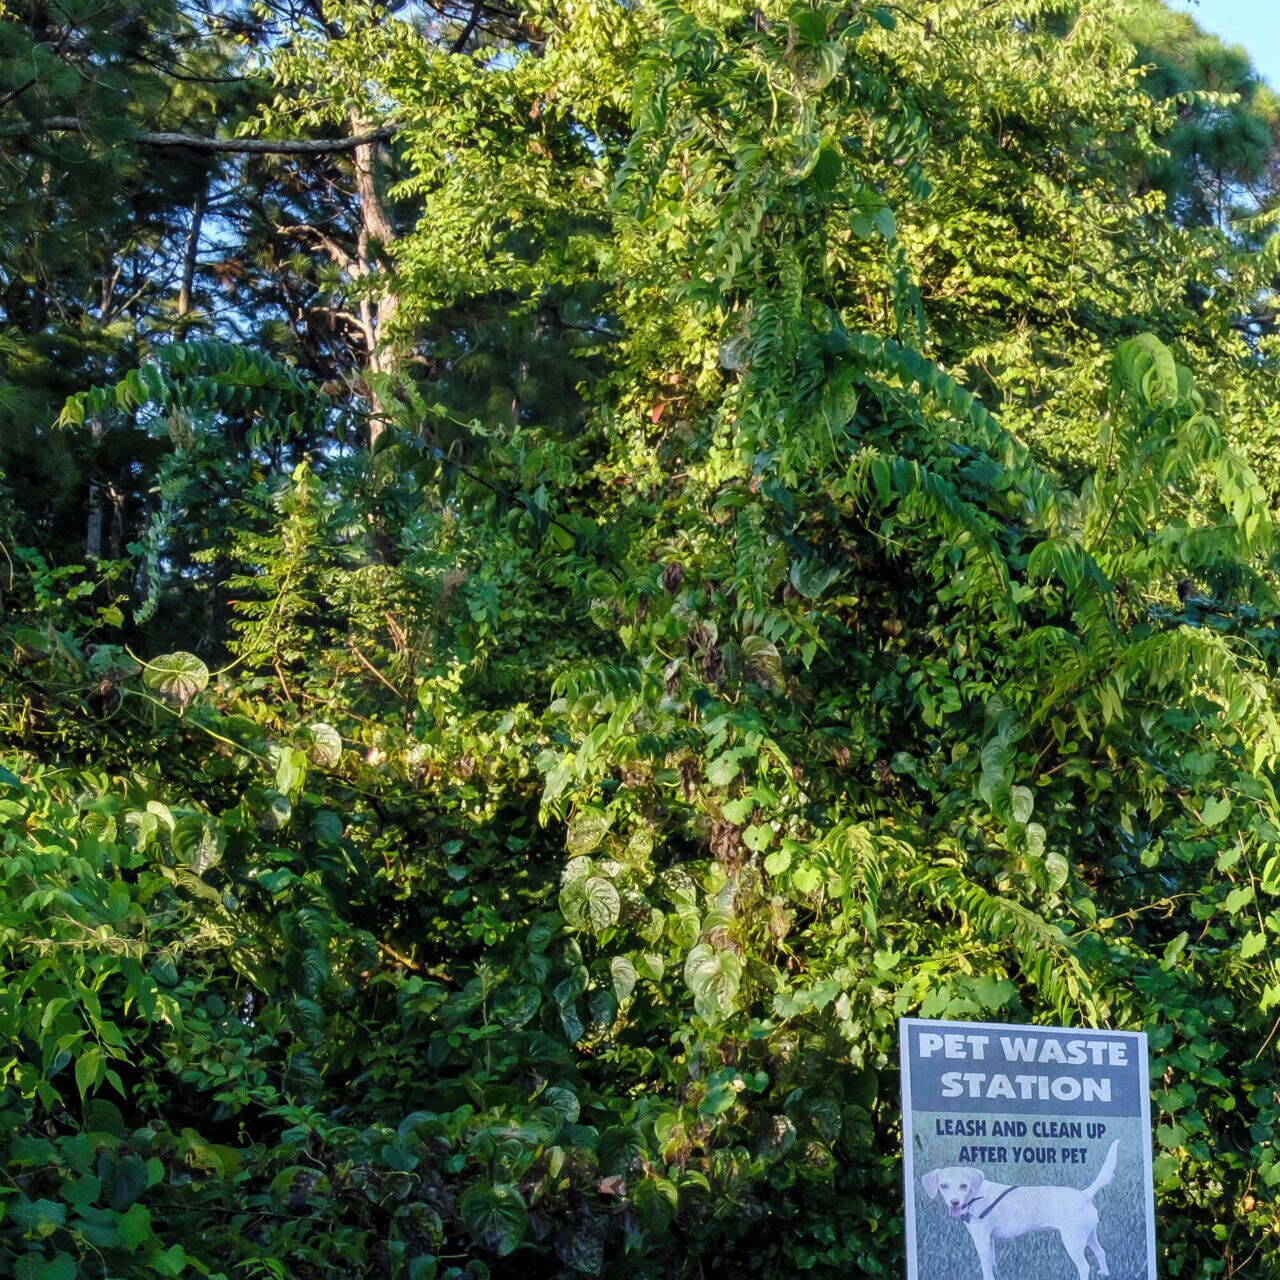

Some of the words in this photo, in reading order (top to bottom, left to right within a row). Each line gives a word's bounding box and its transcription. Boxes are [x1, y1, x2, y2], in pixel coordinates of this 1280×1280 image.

[918, 1033, 990, 1060] PET
[1000, 1036, 1129, 1067] WASTE
[941, 1071, 1112, 1102] STATION
[936, 1119, 987, 1137] LEASH
[991, 1120, 1028, 1138] AND
[1032, 1121, 1082, 1139] CLEAN
[1086, 1122, 1106, 1140] UP
[958, 1146, 1008, 1163] AFTER
[1012, 1146, 1057, 1164] YOUR
[1061, 1147, 1088, 1164] PET
